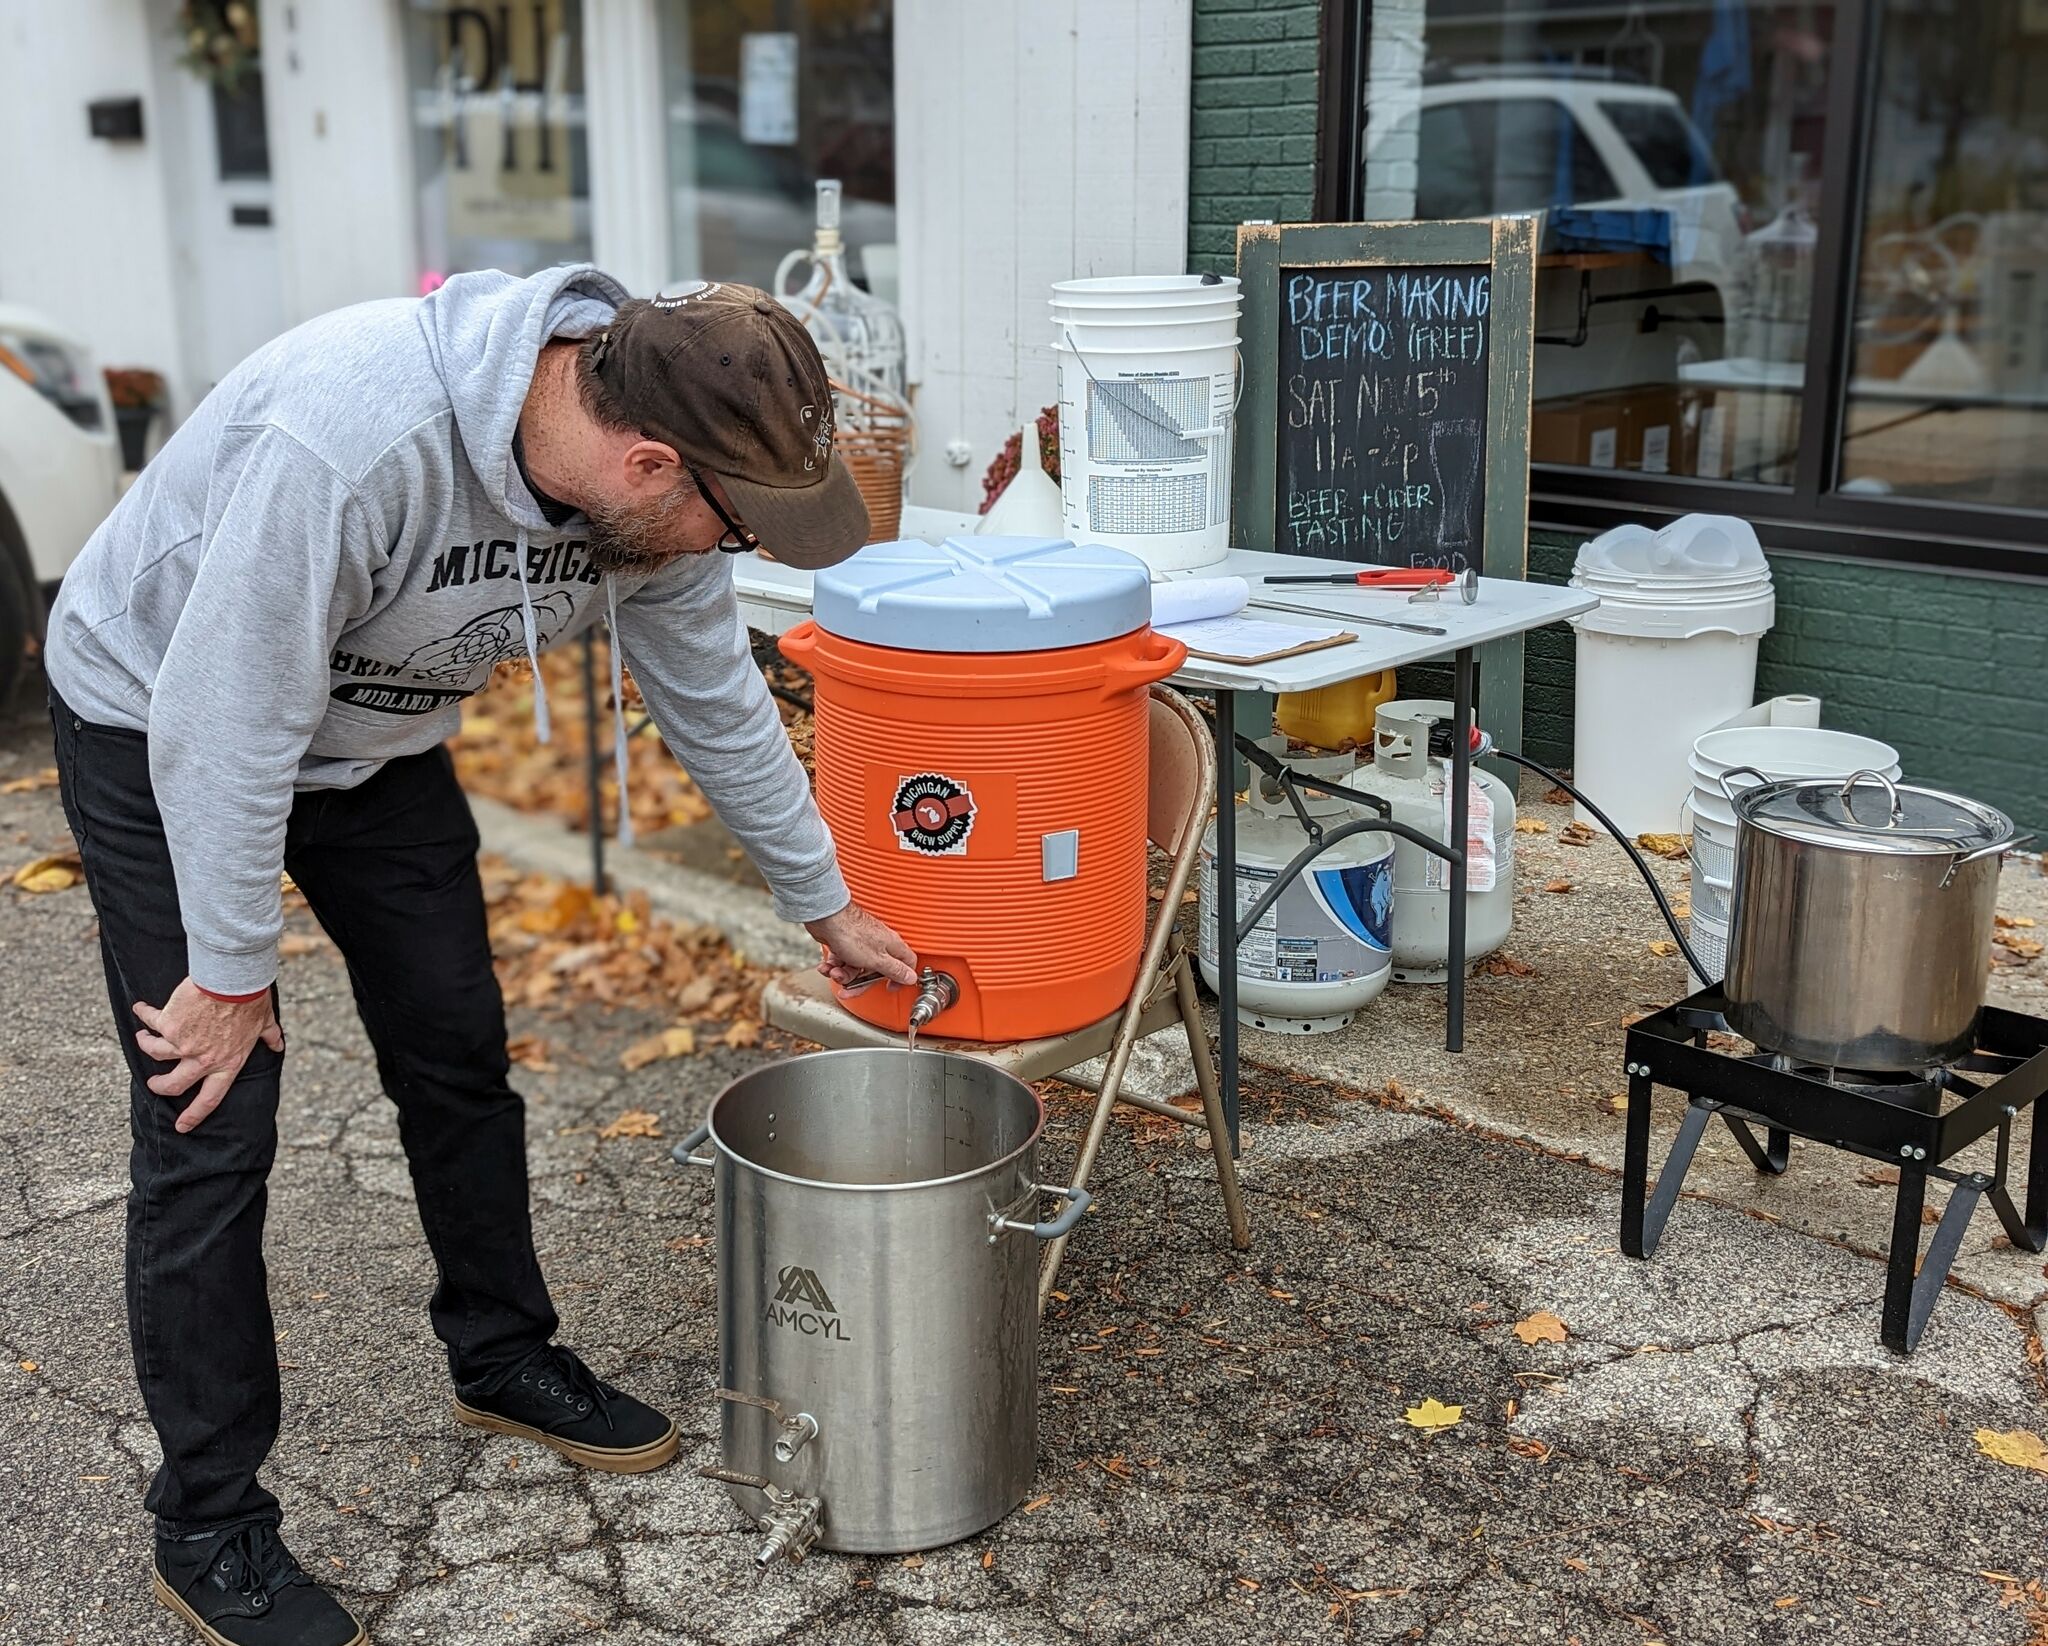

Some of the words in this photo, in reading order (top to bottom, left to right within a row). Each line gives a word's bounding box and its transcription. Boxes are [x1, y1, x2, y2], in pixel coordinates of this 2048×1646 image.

[1288, 274, 1377, 325] BEER
[1385, 271, 1490, 321] MAKING
[1408, 320, 1484, 365] (FREE)
[1288, 488, 1353, 518] BEER
[1289, 514, 1405, 550] TASTING
[425, 539, 603, 594] MICHIGA
[902, 781, 950, 808] MICHIGAN
[911, 829, 936, 846] BREW
[937, 818, 964, 846] SUPPLY
[765, 1302, 851, 1341] AMCYL
